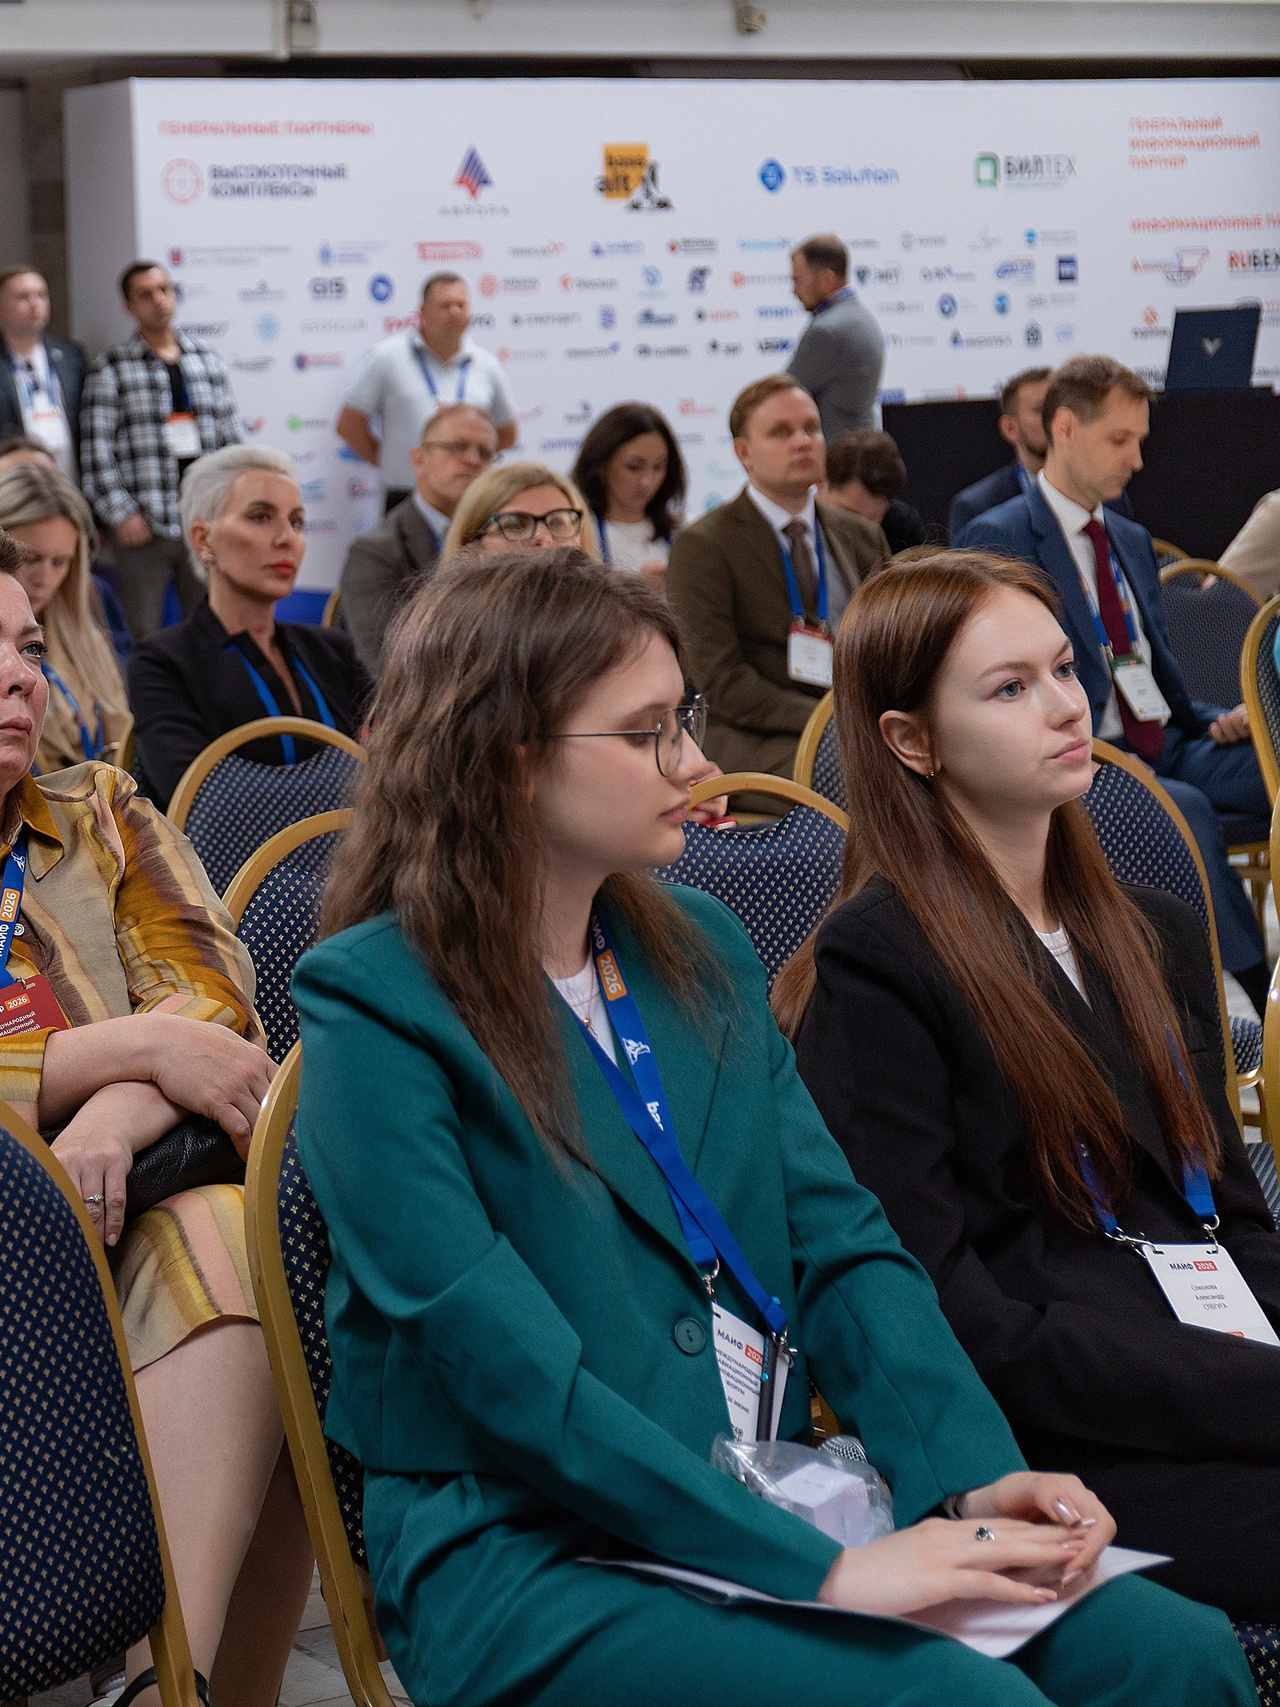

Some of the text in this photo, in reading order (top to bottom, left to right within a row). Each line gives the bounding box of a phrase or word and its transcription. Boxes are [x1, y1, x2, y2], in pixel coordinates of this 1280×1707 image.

[1, 892, 17, 919] 2026
[600, 955, 622, 994] 2026
[7, 995, 28, 1009] 2026
[1169, 1262, 1215, 1270] МАИФ 2026
[717, 1329, 743, 1350] МАИФ
